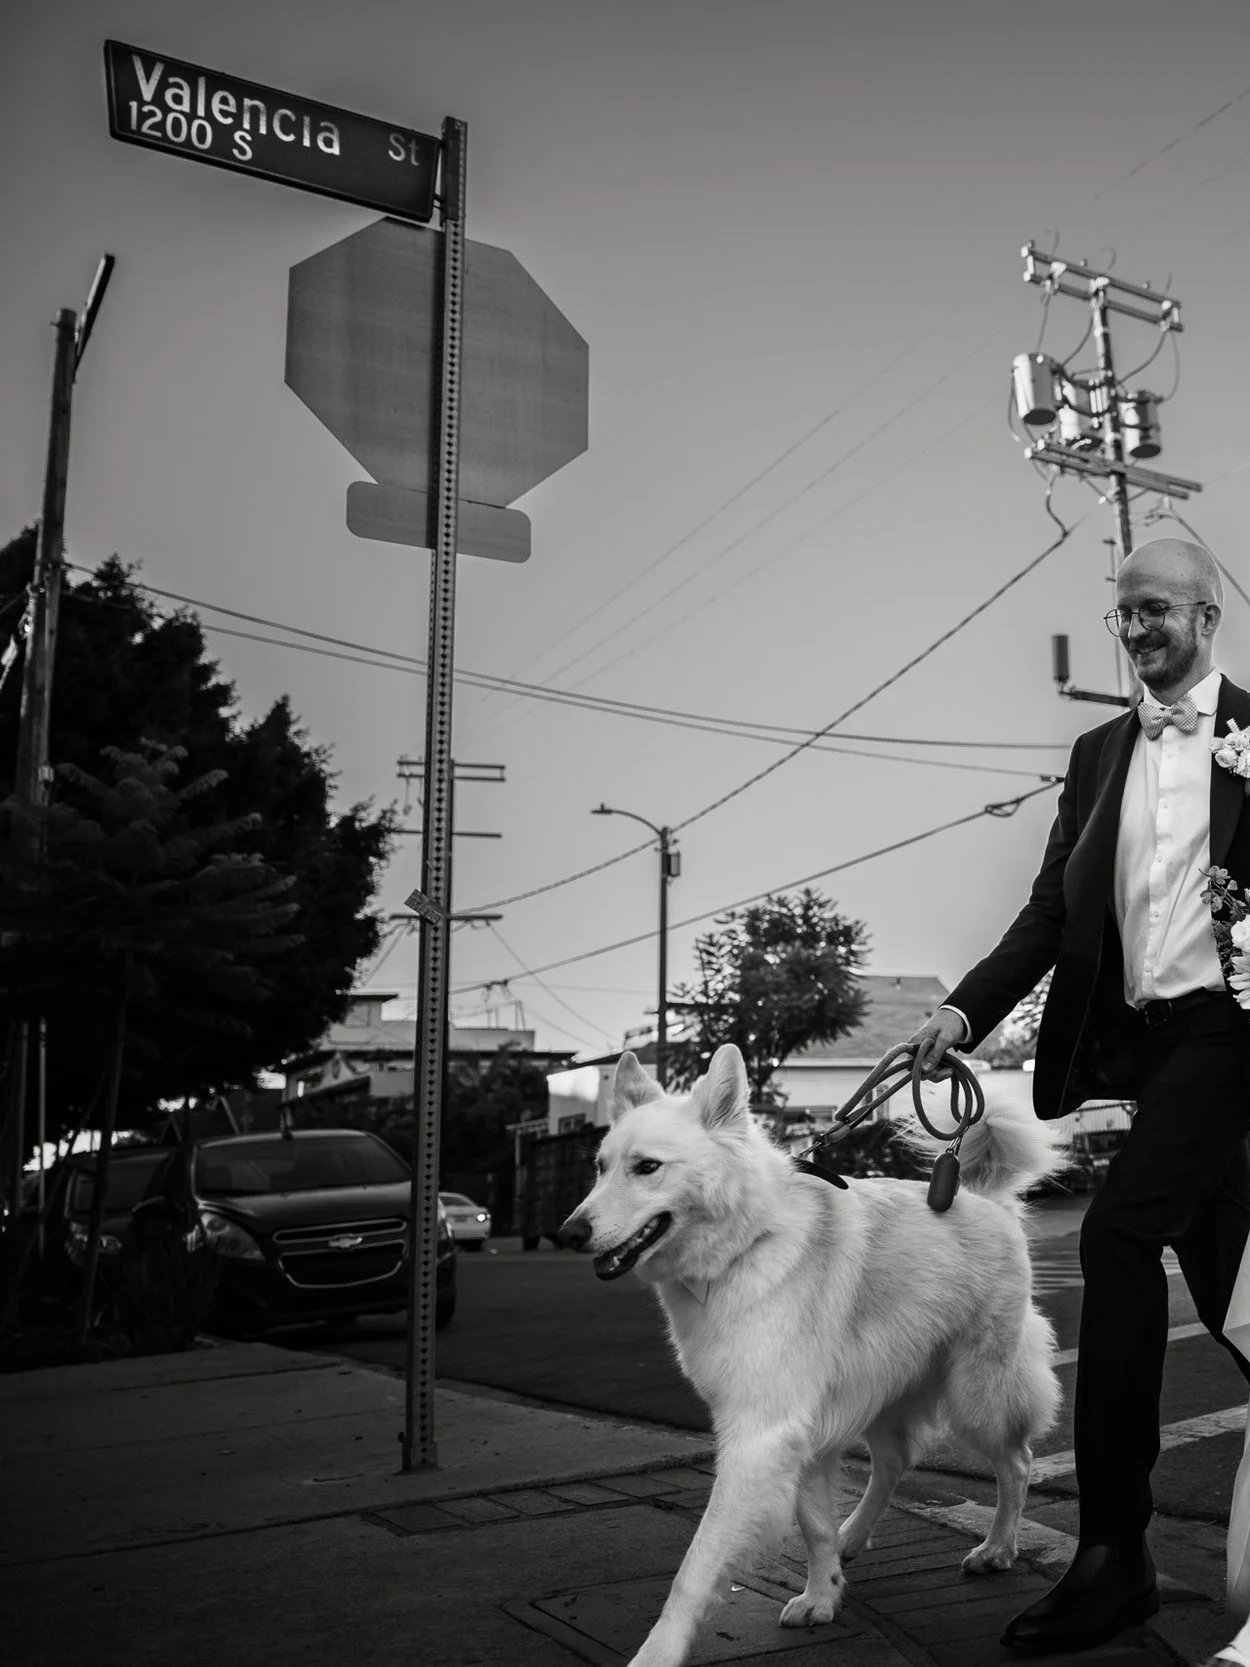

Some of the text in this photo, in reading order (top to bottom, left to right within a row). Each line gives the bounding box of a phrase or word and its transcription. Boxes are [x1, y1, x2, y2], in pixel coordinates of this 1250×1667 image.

[128, 100, 254, 161] 1200 S
[132, 54, 420, 166] Valencia St
